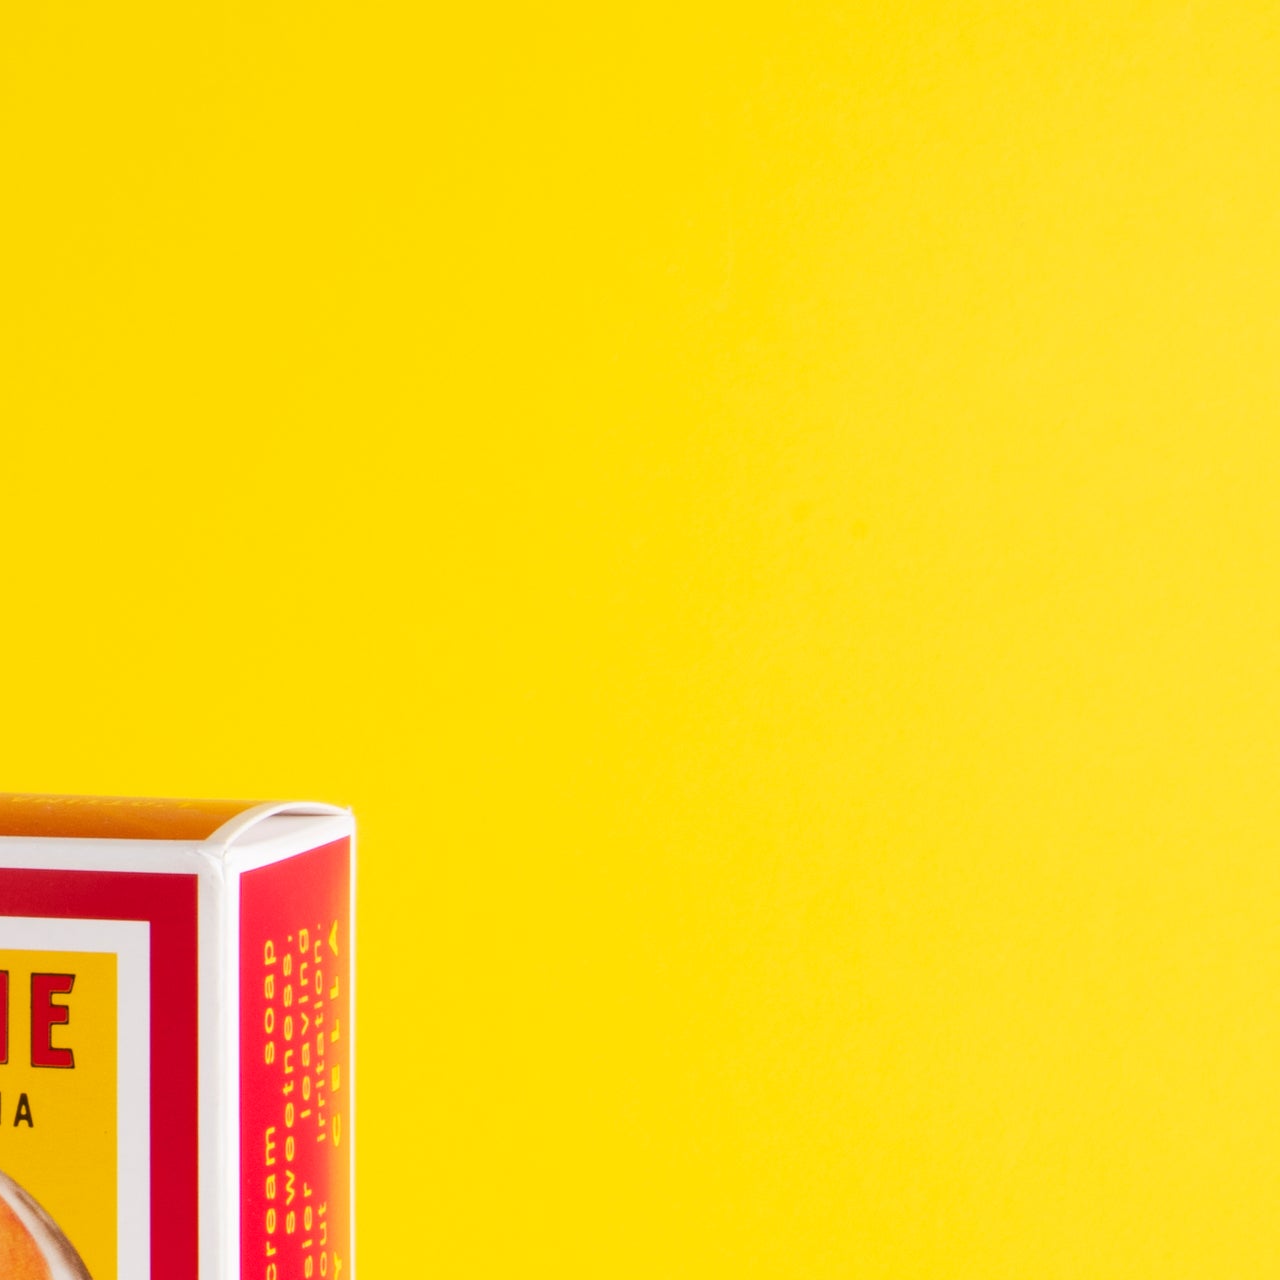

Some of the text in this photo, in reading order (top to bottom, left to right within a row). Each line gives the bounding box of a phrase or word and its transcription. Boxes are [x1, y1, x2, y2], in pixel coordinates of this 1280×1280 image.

[264, 939, 277, 1065] soap
[283, 934, 296, 1234] sweetness.
[298, 928, 312, 1118] leaving
[328, 919, 341, 1147] CELLA
